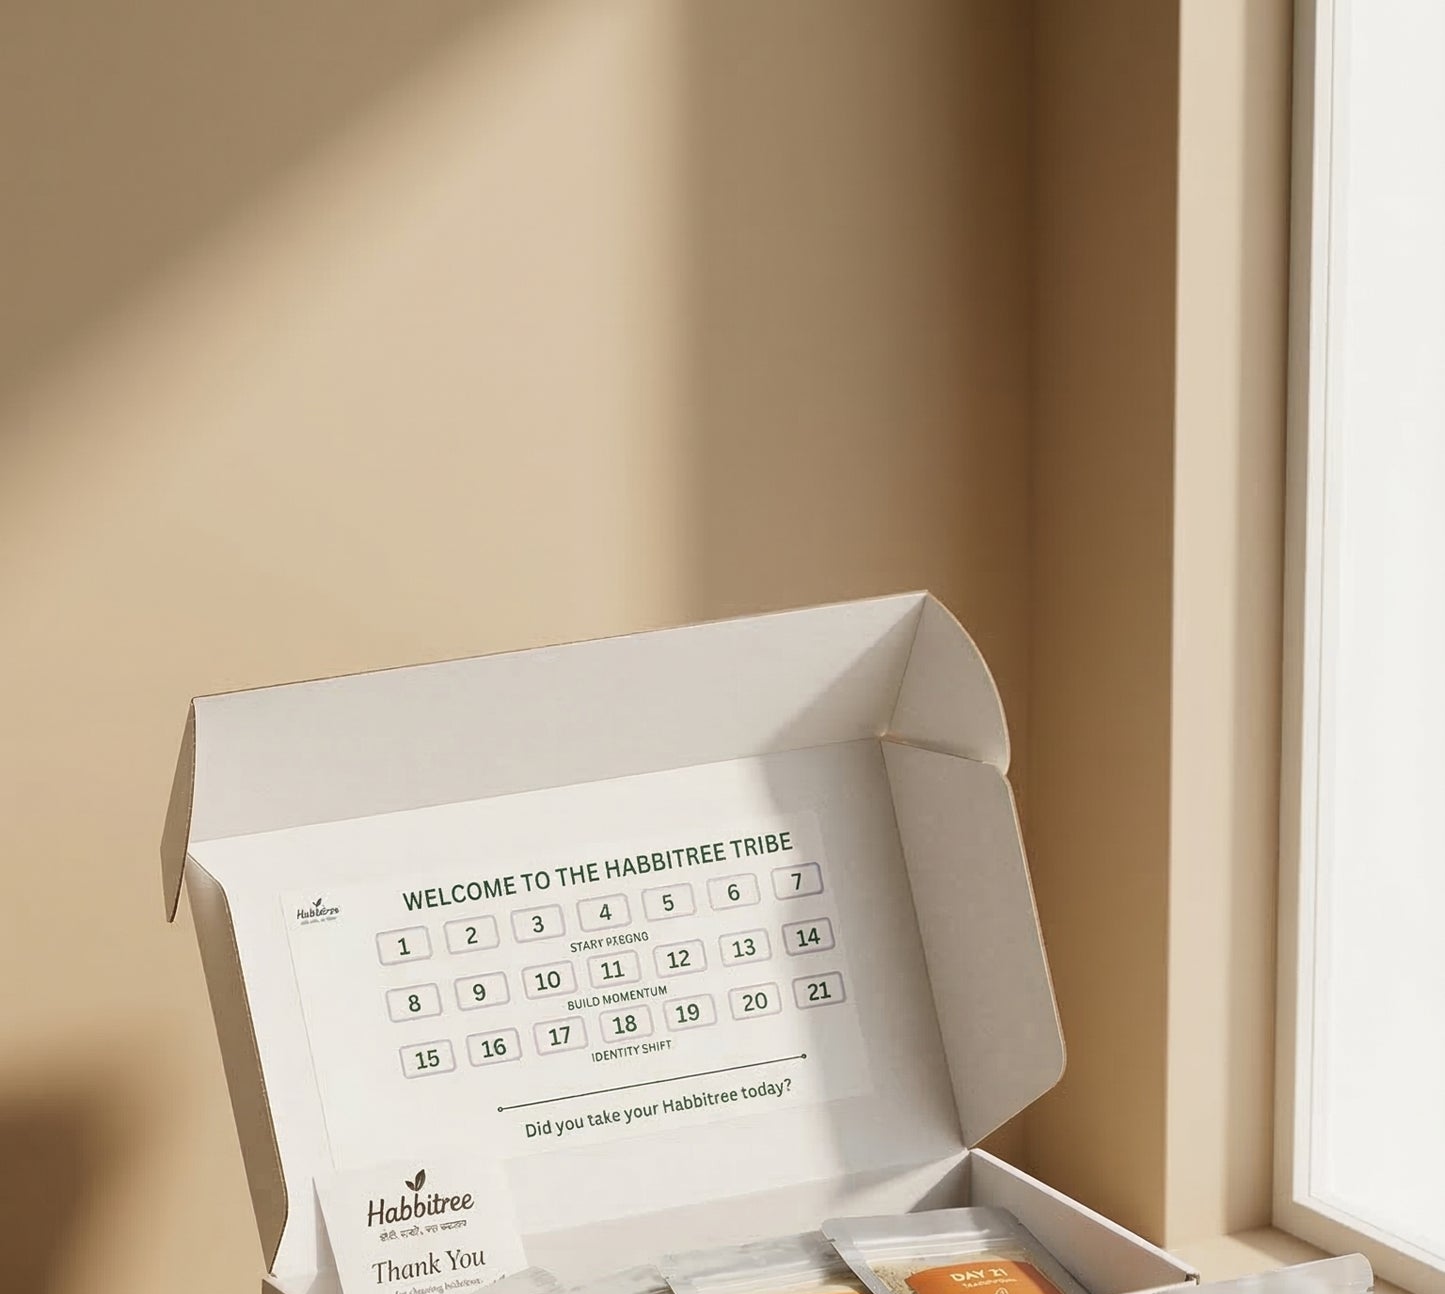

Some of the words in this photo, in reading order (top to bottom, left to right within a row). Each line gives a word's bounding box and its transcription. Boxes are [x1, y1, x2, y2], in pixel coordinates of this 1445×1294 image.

[402, 876, 517, 911] WELCOME
[520, 871, 551, 892] TO
[555, 863, 600, 887] THE
[604, 842, 727, 879] HABBITREE
[730, 832, 793, 858] TRIBE
[397, 937, 411, 956] 1
[465, 927, 478, 944] 2
[531, 915, 544, 933] 3
[599, 904, 612, 921] 4
[662, 894, 675, 911] 5
[727, 884, 740, 901] 6
[791, 873, 802, 890] 7
[408, 994, 422, 1013] 8
[472, 984, 486, 1002] 9
[534, 971, 561, 991] 10
[601, 961, 625, 980] 11
[667, 950, 691, 969] 12
[732, 939, 756, 958] 13
[797, 928, 820, 947] 14
[567, 996, 600, 1011] BUILD
[602, 985, 668, 1005] MOMENTUM
[415, 1050, 440, 1070] 15
[481, 1038, 506, 1058] 16
[549, 1027, 570, 1045] 17
[612, 1015, 637, 1034] 18
[675, 1004, 700, 1023] 19
[742, 992, 768, 1011] 20
[807, 982, 831, 1001] 21
[591, 1045, 641, 1062] IDENTITY
[641, 1040, 672, 1053] SHIFT
[526, 1121, 552, 1138] Did
[555, 1117, 584, 1136] you
[588, 1109, 621, 1127] take
[624, 1105, 659, 1124] your
[662, 1090, 738, 1114] Habbitree
[741, 1078, 792, 1099] today?
[367, 1193, 475, 1227] Habbitree
[371, 1252, 442, 1284] Thank
[444, 1249, 486, 1271] You
[950, 1269, 984, 1281] DAY
